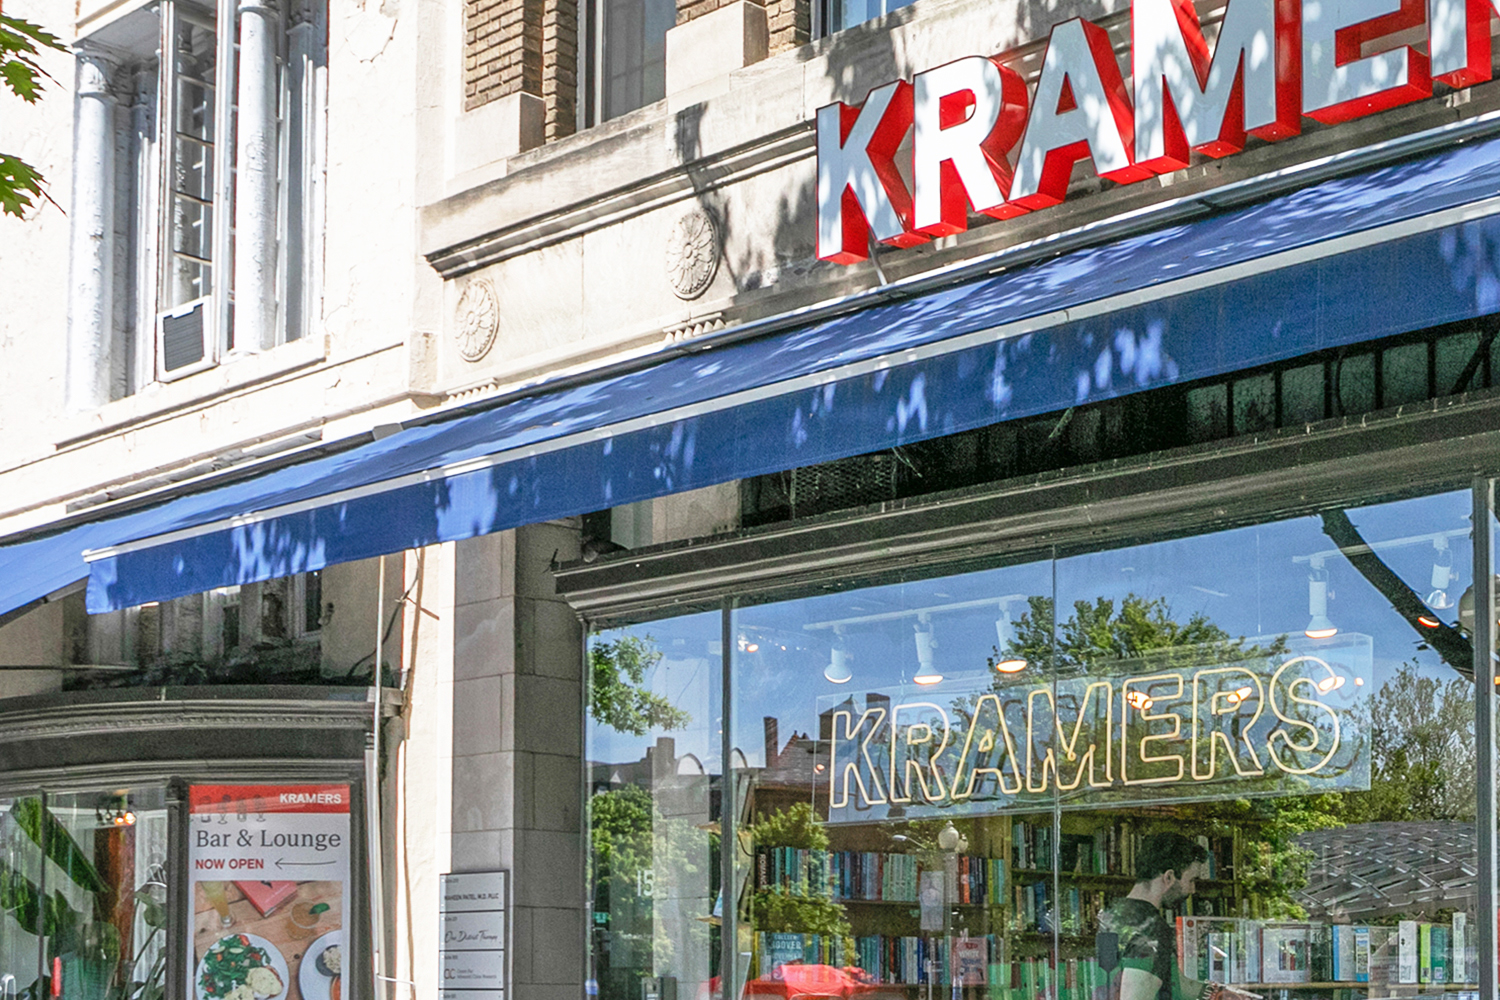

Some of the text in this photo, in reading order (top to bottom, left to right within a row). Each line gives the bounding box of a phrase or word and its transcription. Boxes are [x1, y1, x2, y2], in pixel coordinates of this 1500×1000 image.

[830, 655, 1341, 808] KRAMERS
[279, 793, 342, 804] KRAMERS
[196, 829, 342, 852] Bar & Lounge
[195, 858, 264, 870] NOW OPEN
